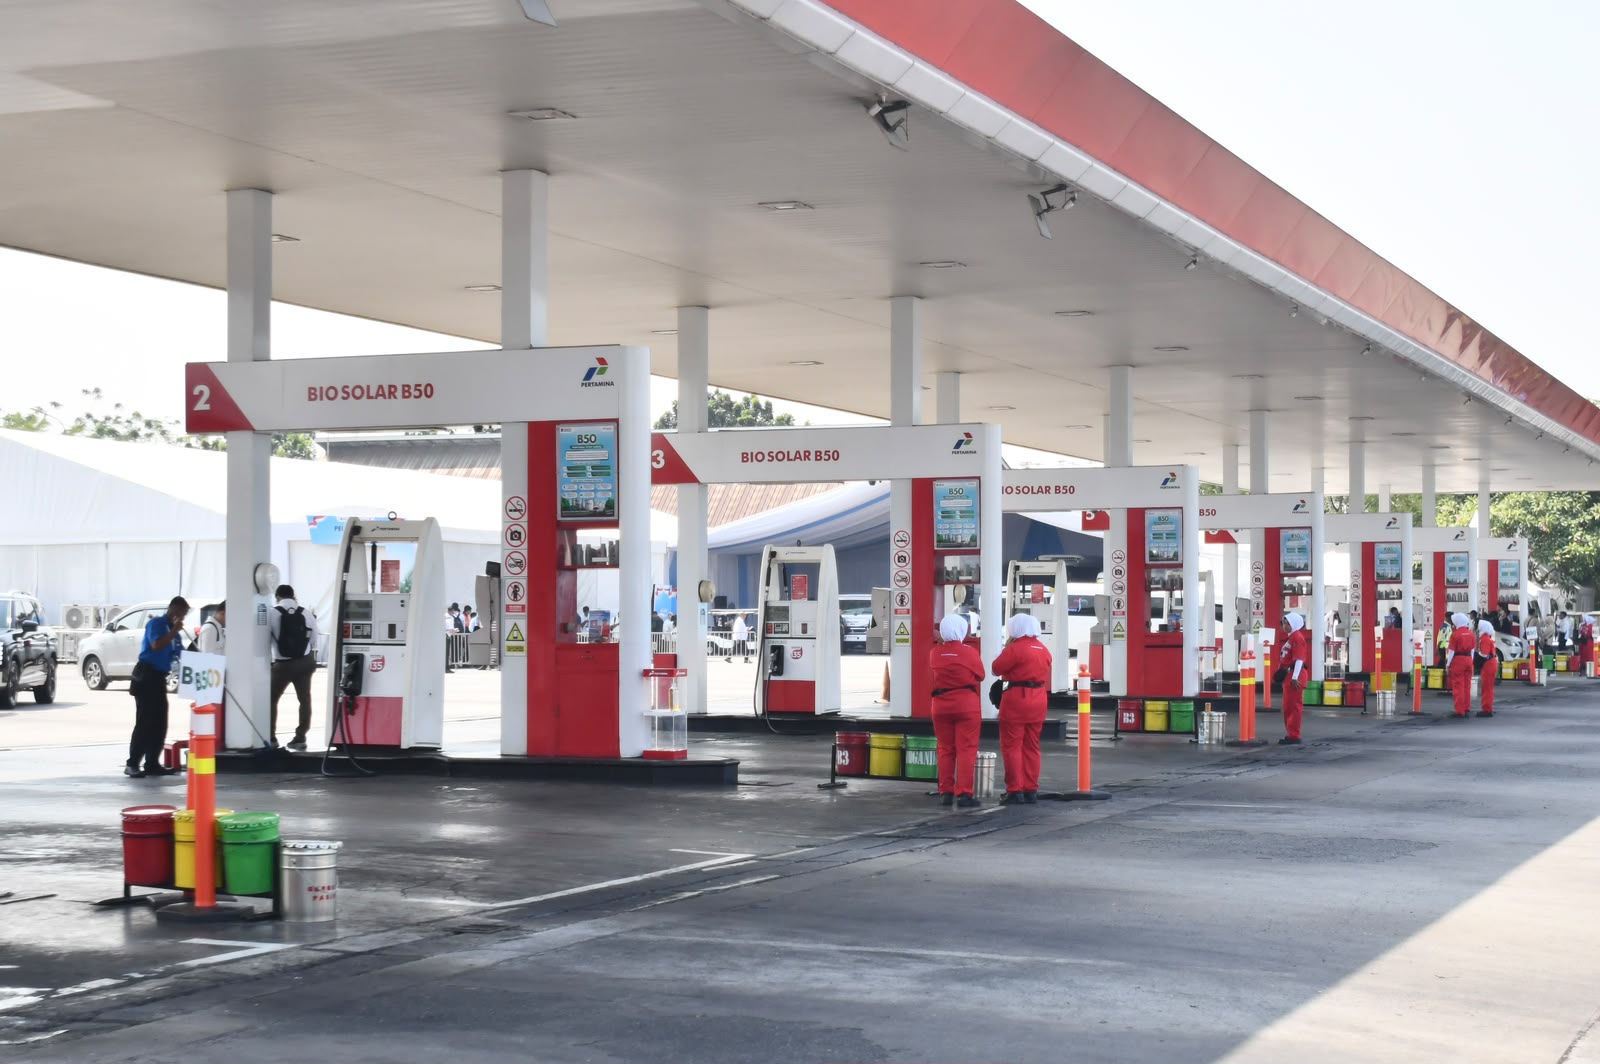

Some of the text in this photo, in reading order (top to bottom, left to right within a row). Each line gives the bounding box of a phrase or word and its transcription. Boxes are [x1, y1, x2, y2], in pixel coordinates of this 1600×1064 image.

[193, 384, 211, 411] 2
[307, 383, 434, 402] BIO SOLAR B50
[576, 433, 598, 444] B50
[651, 449, 665, 469] 3
[741, 449, 840, 463] BIO SOLAR B50
[948, 487, 964, 495] B50
[1001, 485, 1076, 495] IO SOLAR B50
[1199, 508, 1217, 517] B50
[1123, 712, 1135, 724] B3
[837, 750, 850, 766] B3
